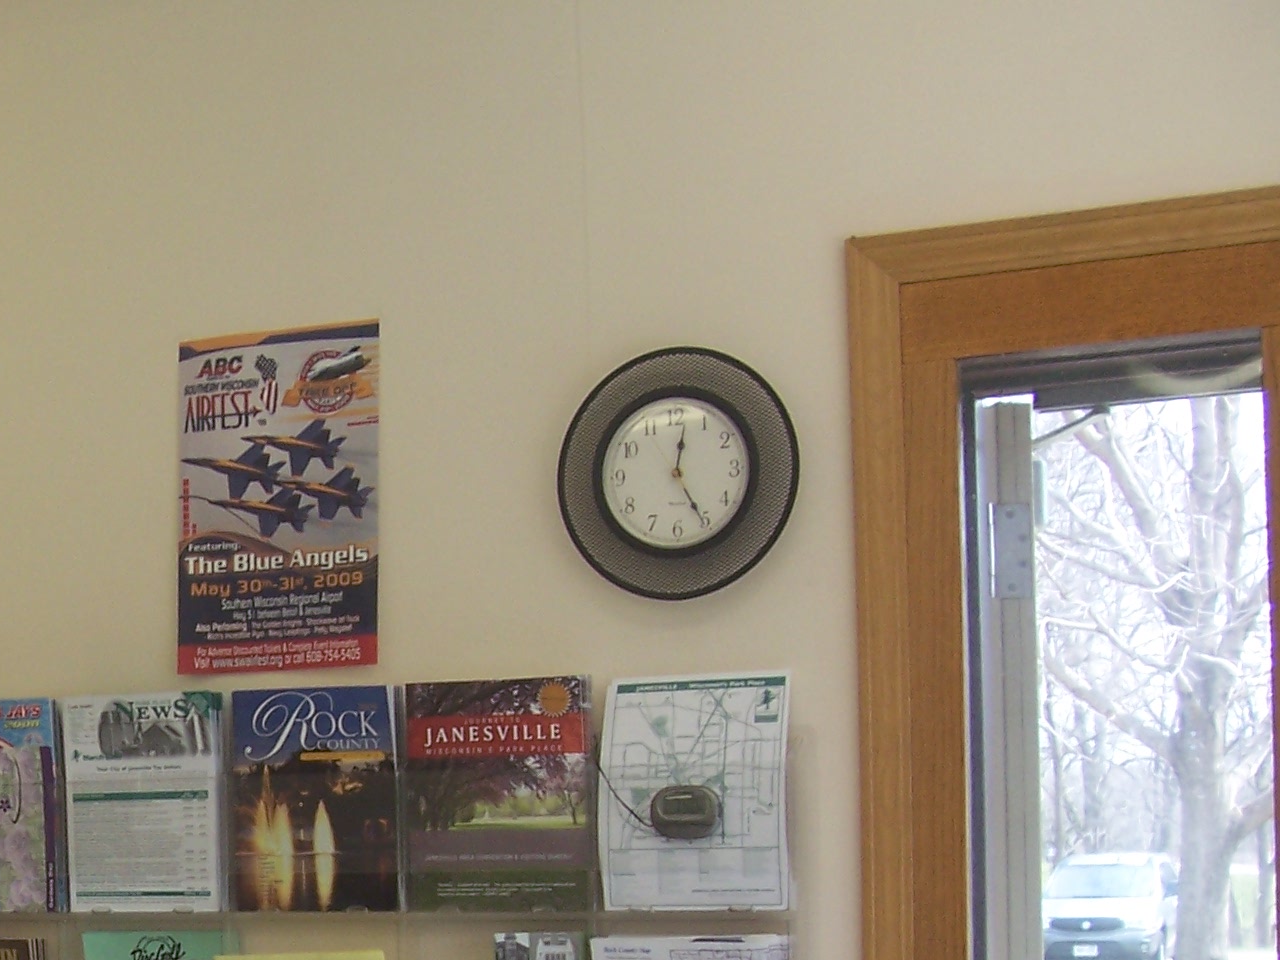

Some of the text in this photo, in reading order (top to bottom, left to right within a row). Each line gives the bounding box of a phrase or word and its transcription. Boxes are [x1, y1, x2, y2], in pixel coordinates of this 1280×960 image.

[197, 355, 244, 379] ABC
[184, 378, 260, 396] SOUTHERN WISCONSIN
[184, 390, 253, 433] AIRFEST
[666, 408, 684, 426] 12
[644, 418, 657, 436] 11
[719, 431, 731, 449] 2
[624, 440, 639, 459] 10
[728, 459, 741, 478] 3
[615, 469, 626, 487] 9
[624, 496, 635, 514] 8
[718, 490, 729, 507] 4
[647, 514, 658, 532] 7
[672, 519, 683, 538] 6
[700, 511, 711, 529] 5
[184, 545, 369, 575] The Blue Angels
[190, 582, 231, 597] May
[314, 571, 364, 588] 2009
[6, 703, 42, 719] JAYS
[113, 699, 191, 724] NEWS
[245, 691, 379, 761] ROCK
[317, 737, 380, 752] COUNTY
[424, 723, 562, 748] JANESVILLE
